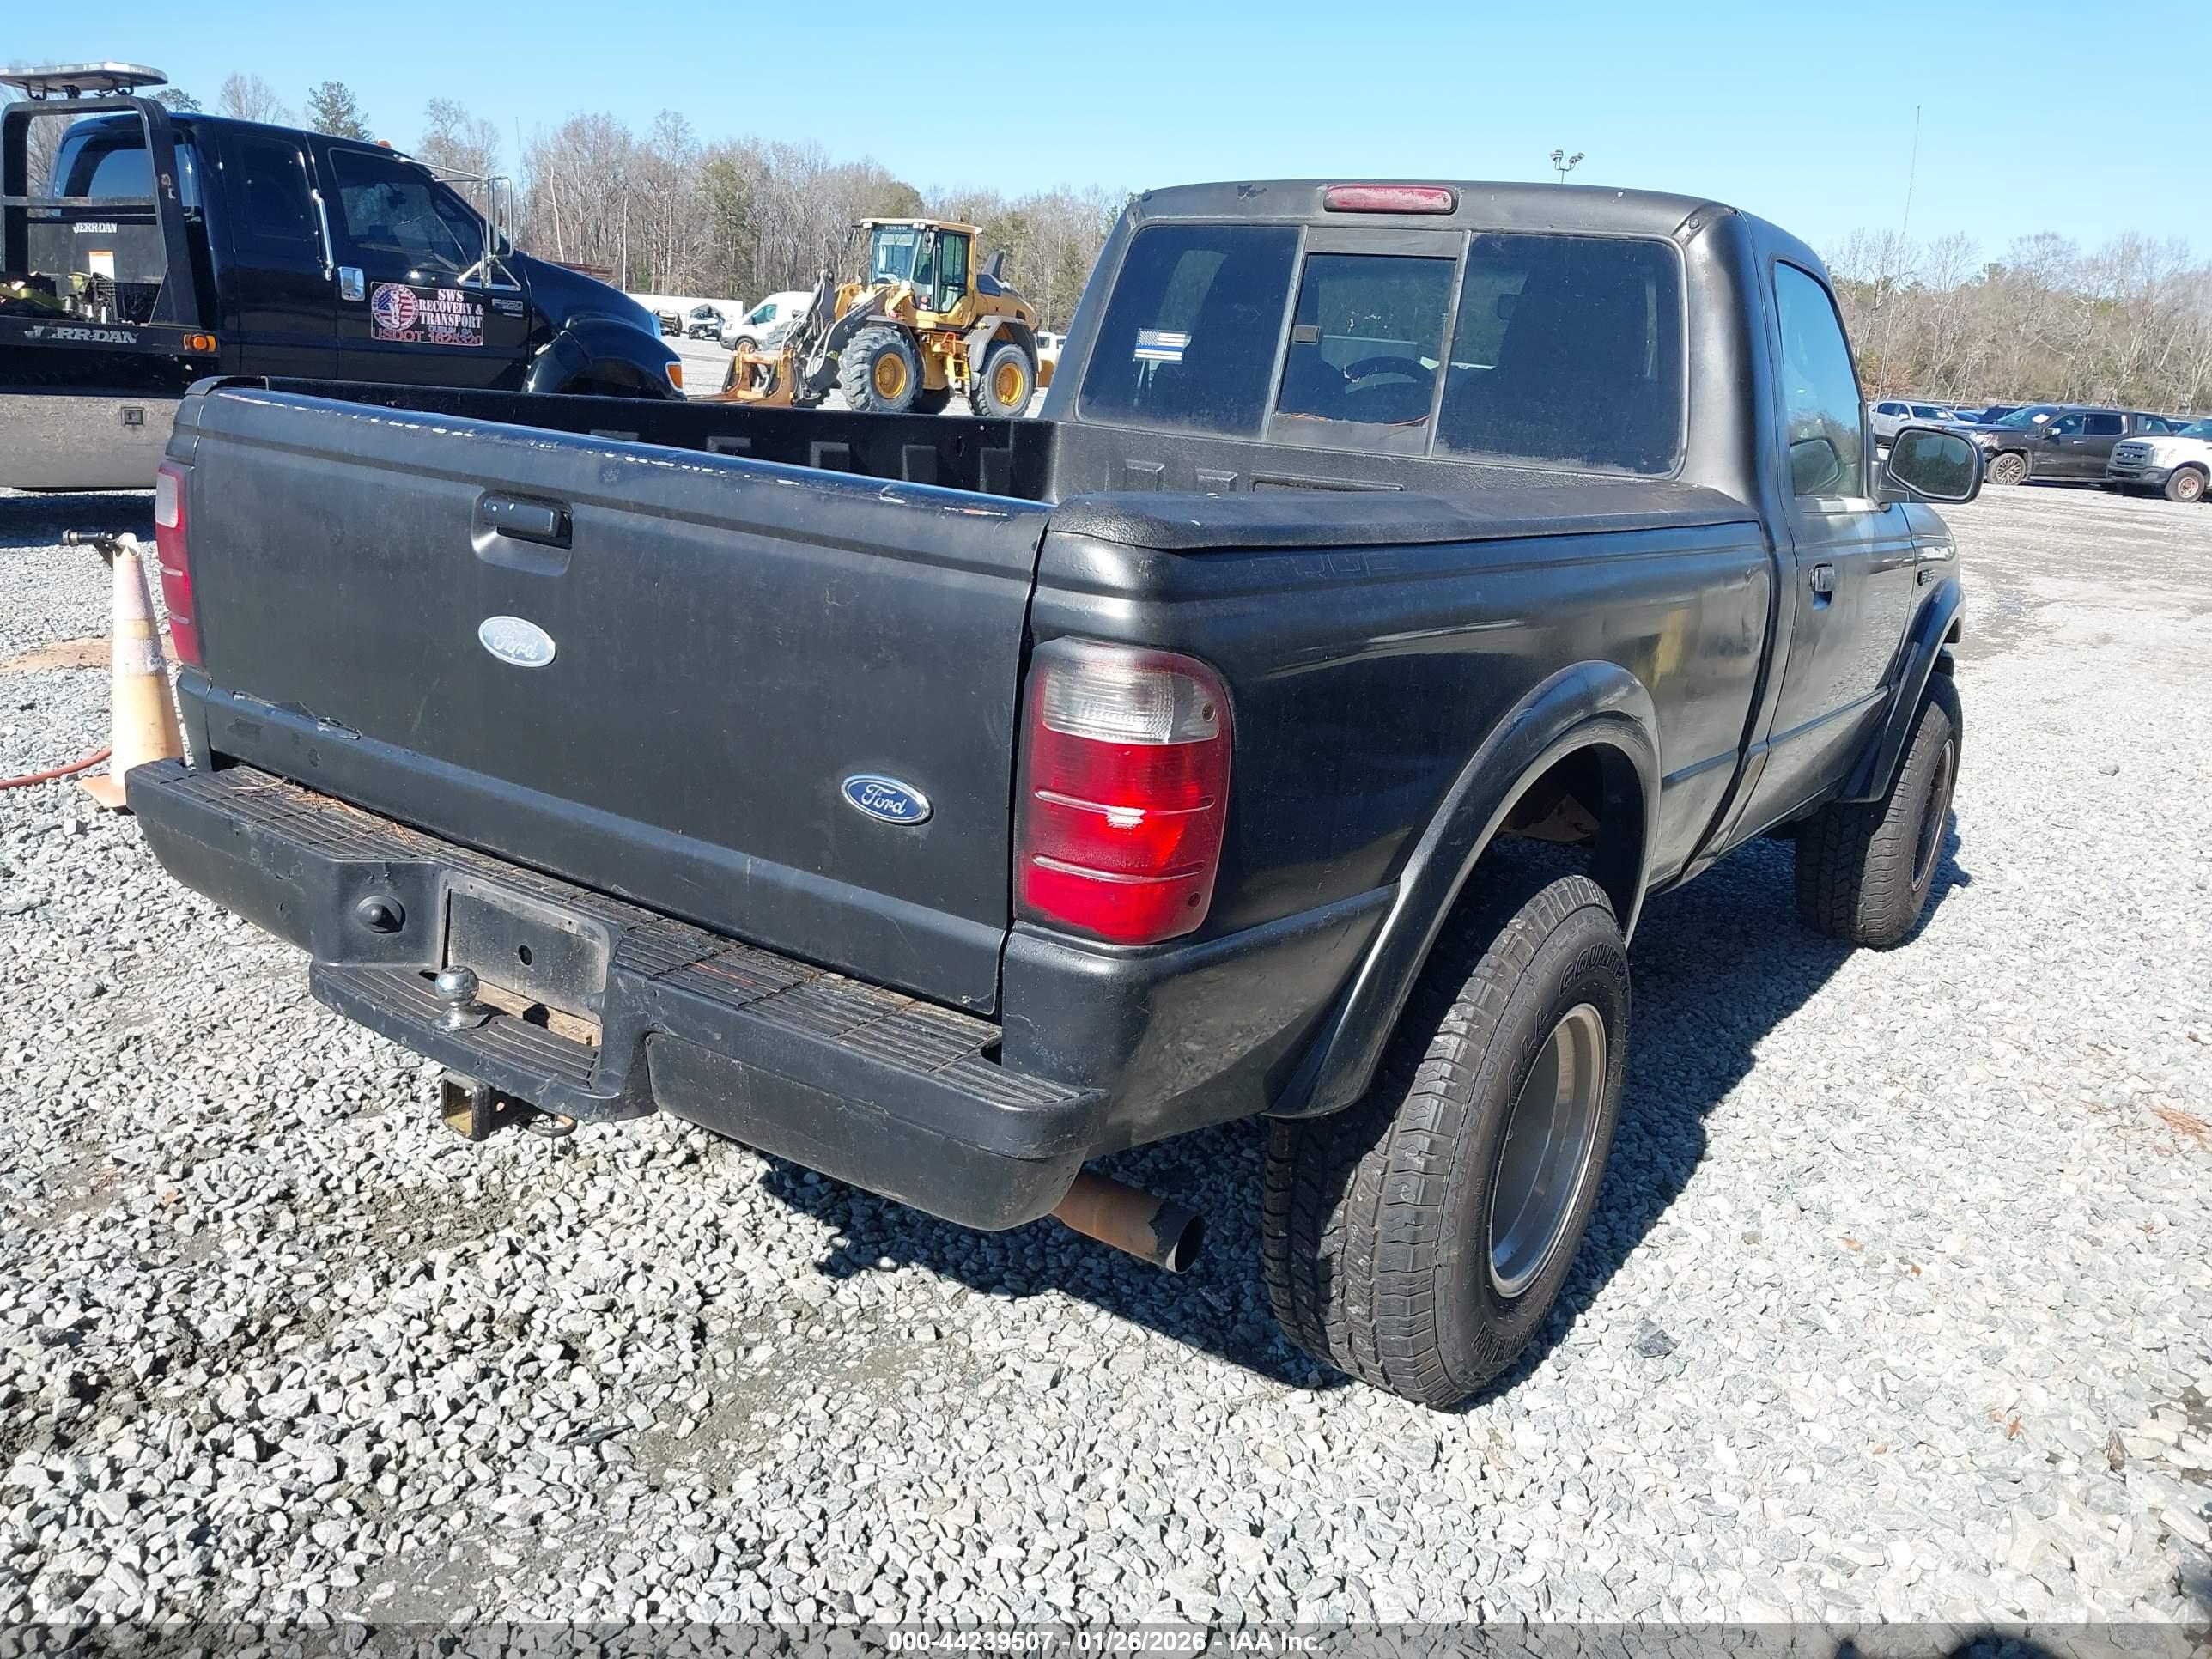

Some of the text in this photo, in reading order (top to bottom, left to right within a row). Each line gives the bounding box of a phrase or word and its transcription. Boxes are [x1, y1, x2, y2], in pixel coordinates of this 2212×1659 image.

[73, 223, 118, 234] JERR-DAN
[437, 289, 465, 302] SWS
[418, 299, 484, 315] RECOVERY &
[419, 311, 483, 329] TRANSPORT
[372, 326, 424, 343] USDOT
[494, 628, 538, 659] Ford
[861, 783, 907, 814] Ford
